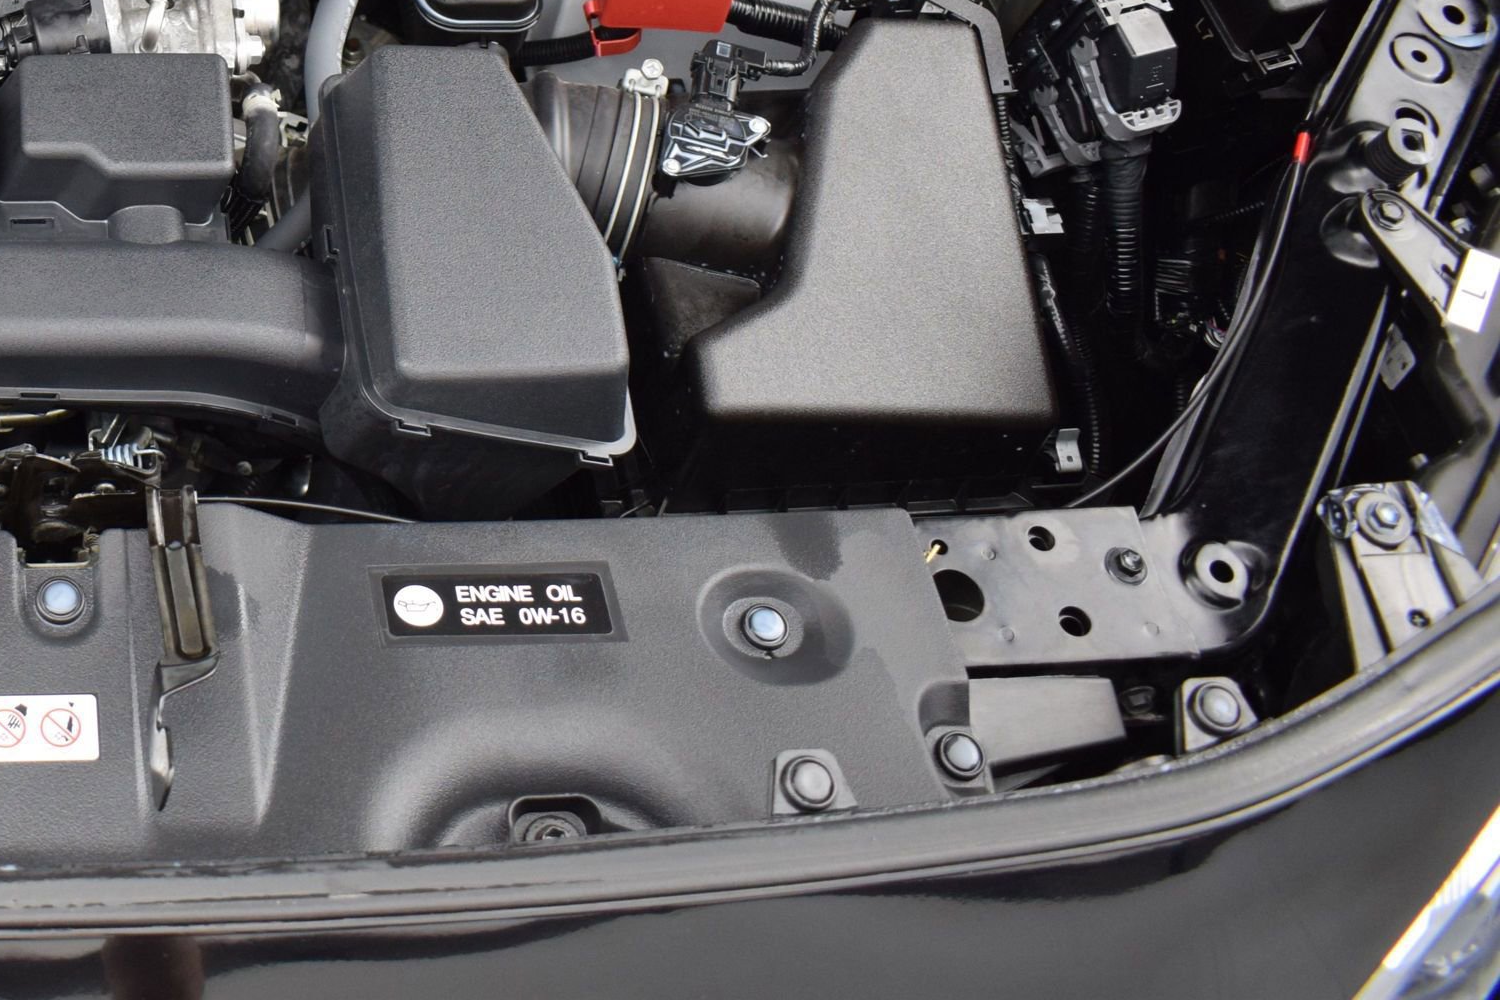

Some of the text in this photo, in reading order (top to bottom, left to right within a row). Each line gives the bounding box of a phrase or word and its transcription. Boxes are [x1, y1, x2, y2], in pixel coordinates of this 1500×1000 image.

[455, 584, 583, 603] ENGINE OIL
[460, 607, 587, 625] SAE 0W-16
